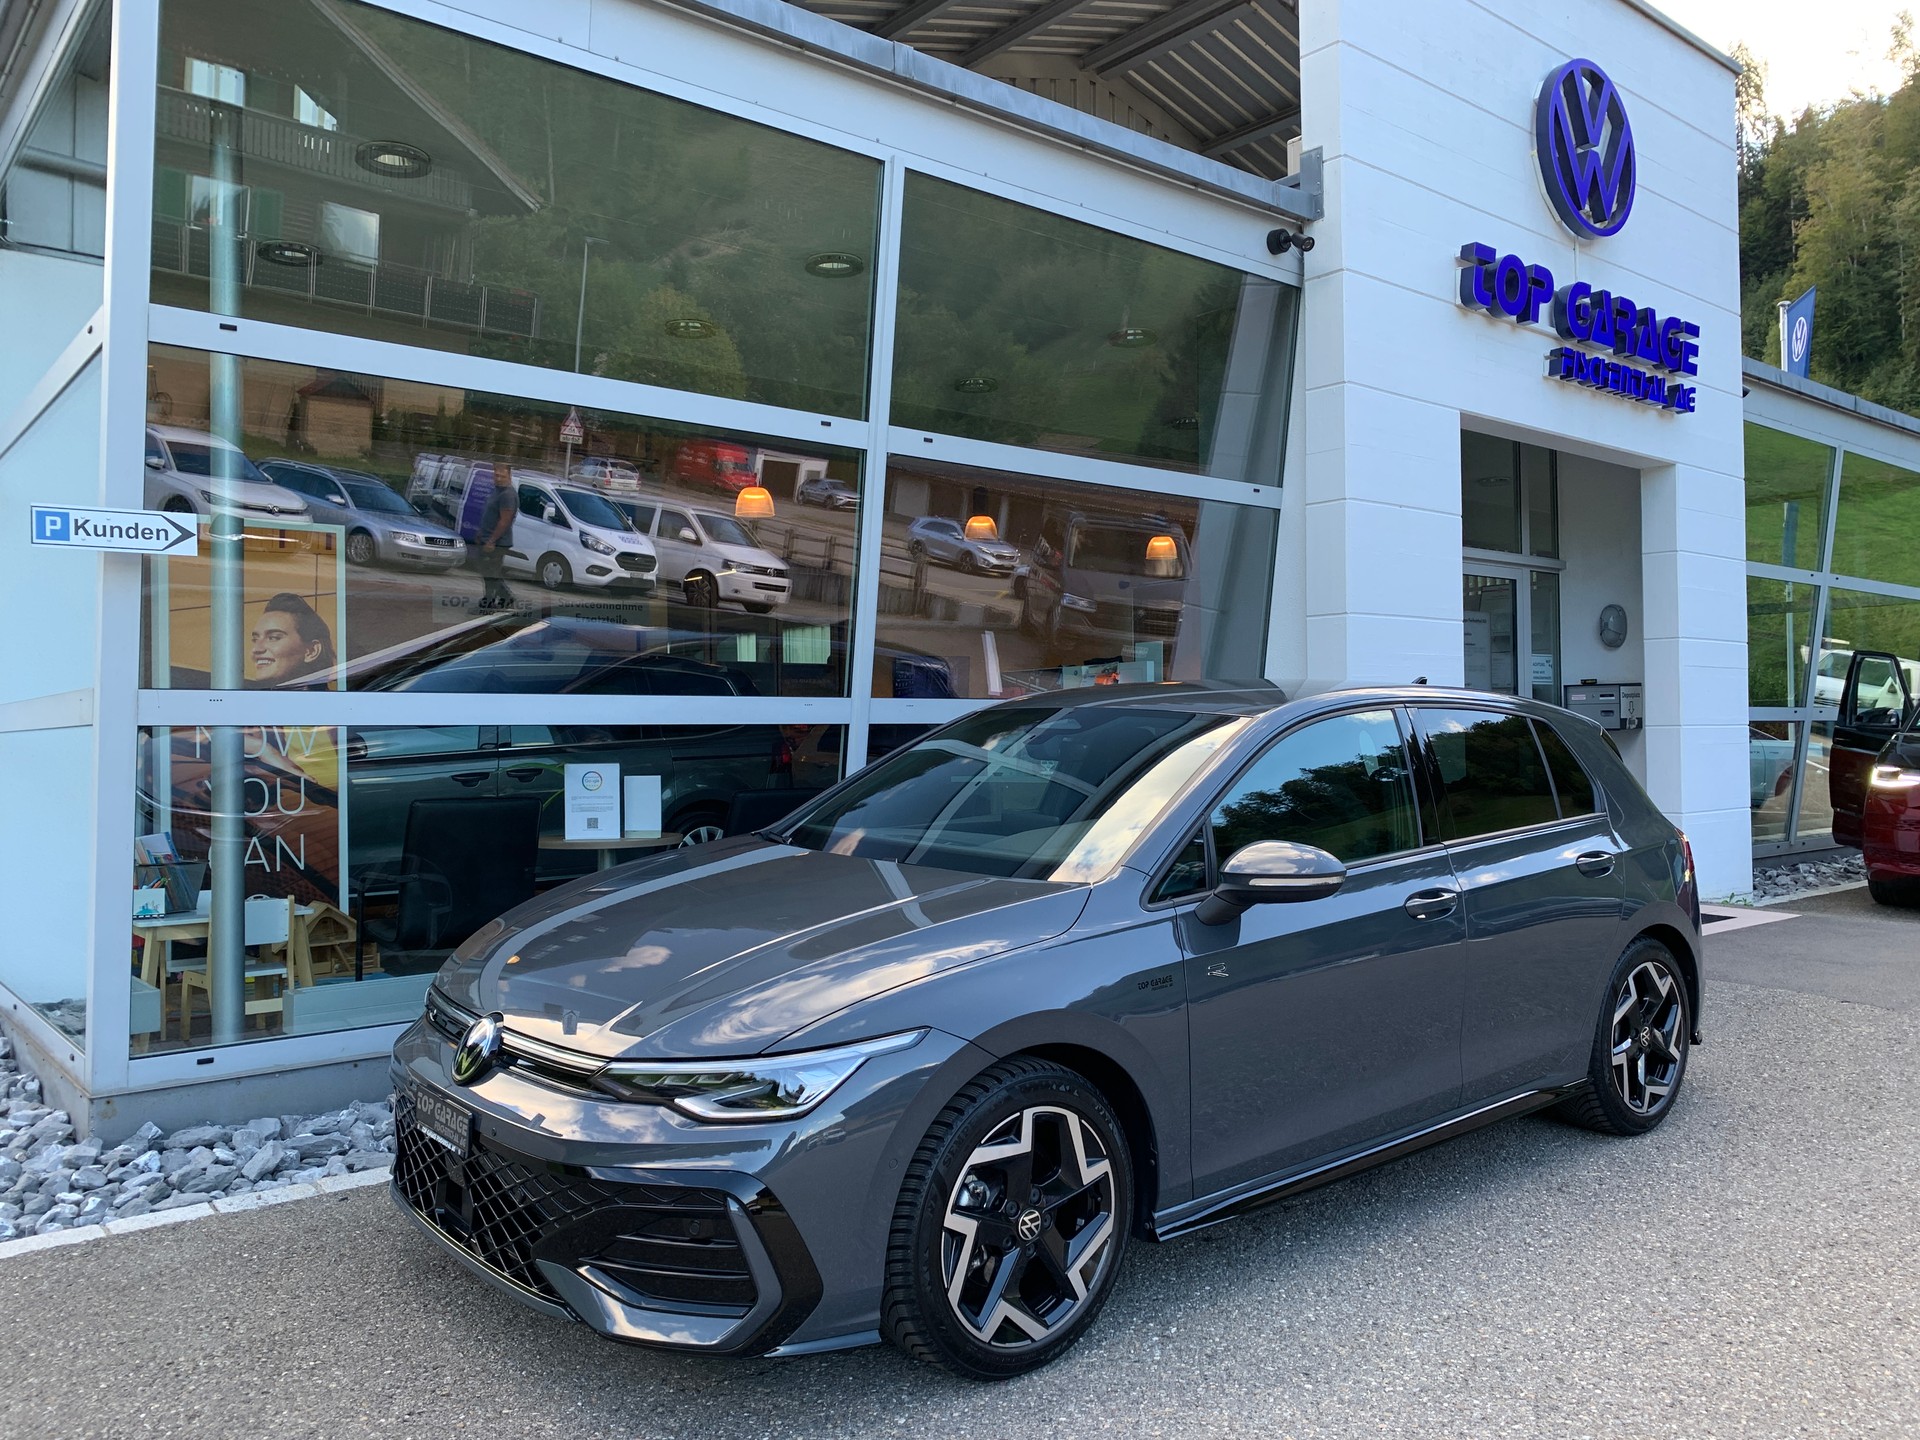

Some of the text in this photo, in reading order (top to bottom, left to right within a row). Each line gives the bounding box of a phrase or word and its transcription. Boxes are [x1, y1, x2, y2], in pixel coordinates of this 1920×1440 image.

[1463, 242, 1700, 377] TOP GARAGE
[1556, 346, 1668, 406] FISCHENTHAL
[45, 515, 169, 542] P Kunden
[441, 596, 533, 610] TOP GARAGE
[558, 598, 643, 611] Serviceannahme
[575, 613, 628, 624] Ersatzteile
[205, 776, 305, 817] OU
[208, 833, 305, 873] AN
[1137, 981, 1150, 990] TOP
[1150, 975, 1173, 986] GARAGE
[417, 1091, 469, 1137] TOP GARAGE
